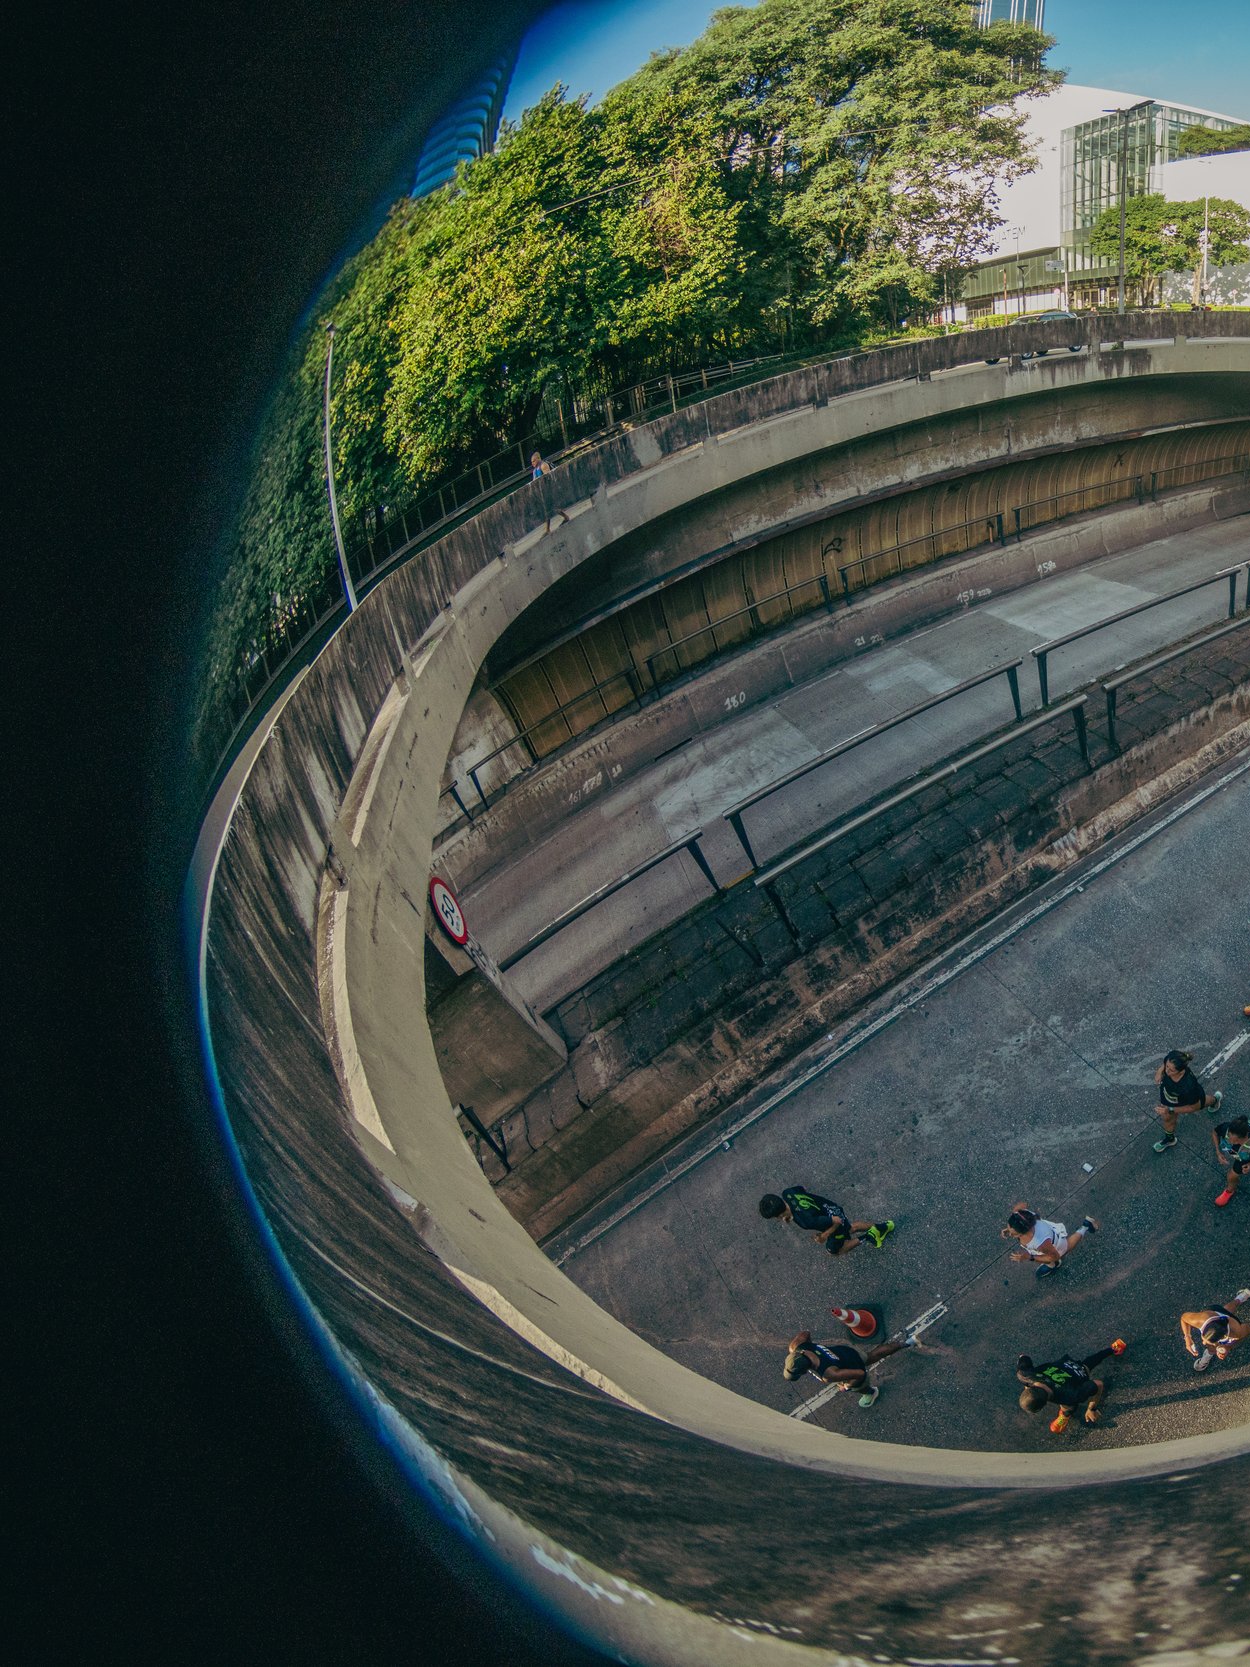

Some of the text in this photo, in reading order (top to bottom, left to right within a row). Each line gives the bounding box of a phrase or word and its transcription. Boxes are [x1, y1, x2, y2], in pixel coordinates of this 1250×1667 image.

[957, 589, 974, 603] 159
[724, 691, 746, 711] 180
[441, 893, 455, 926] 50
